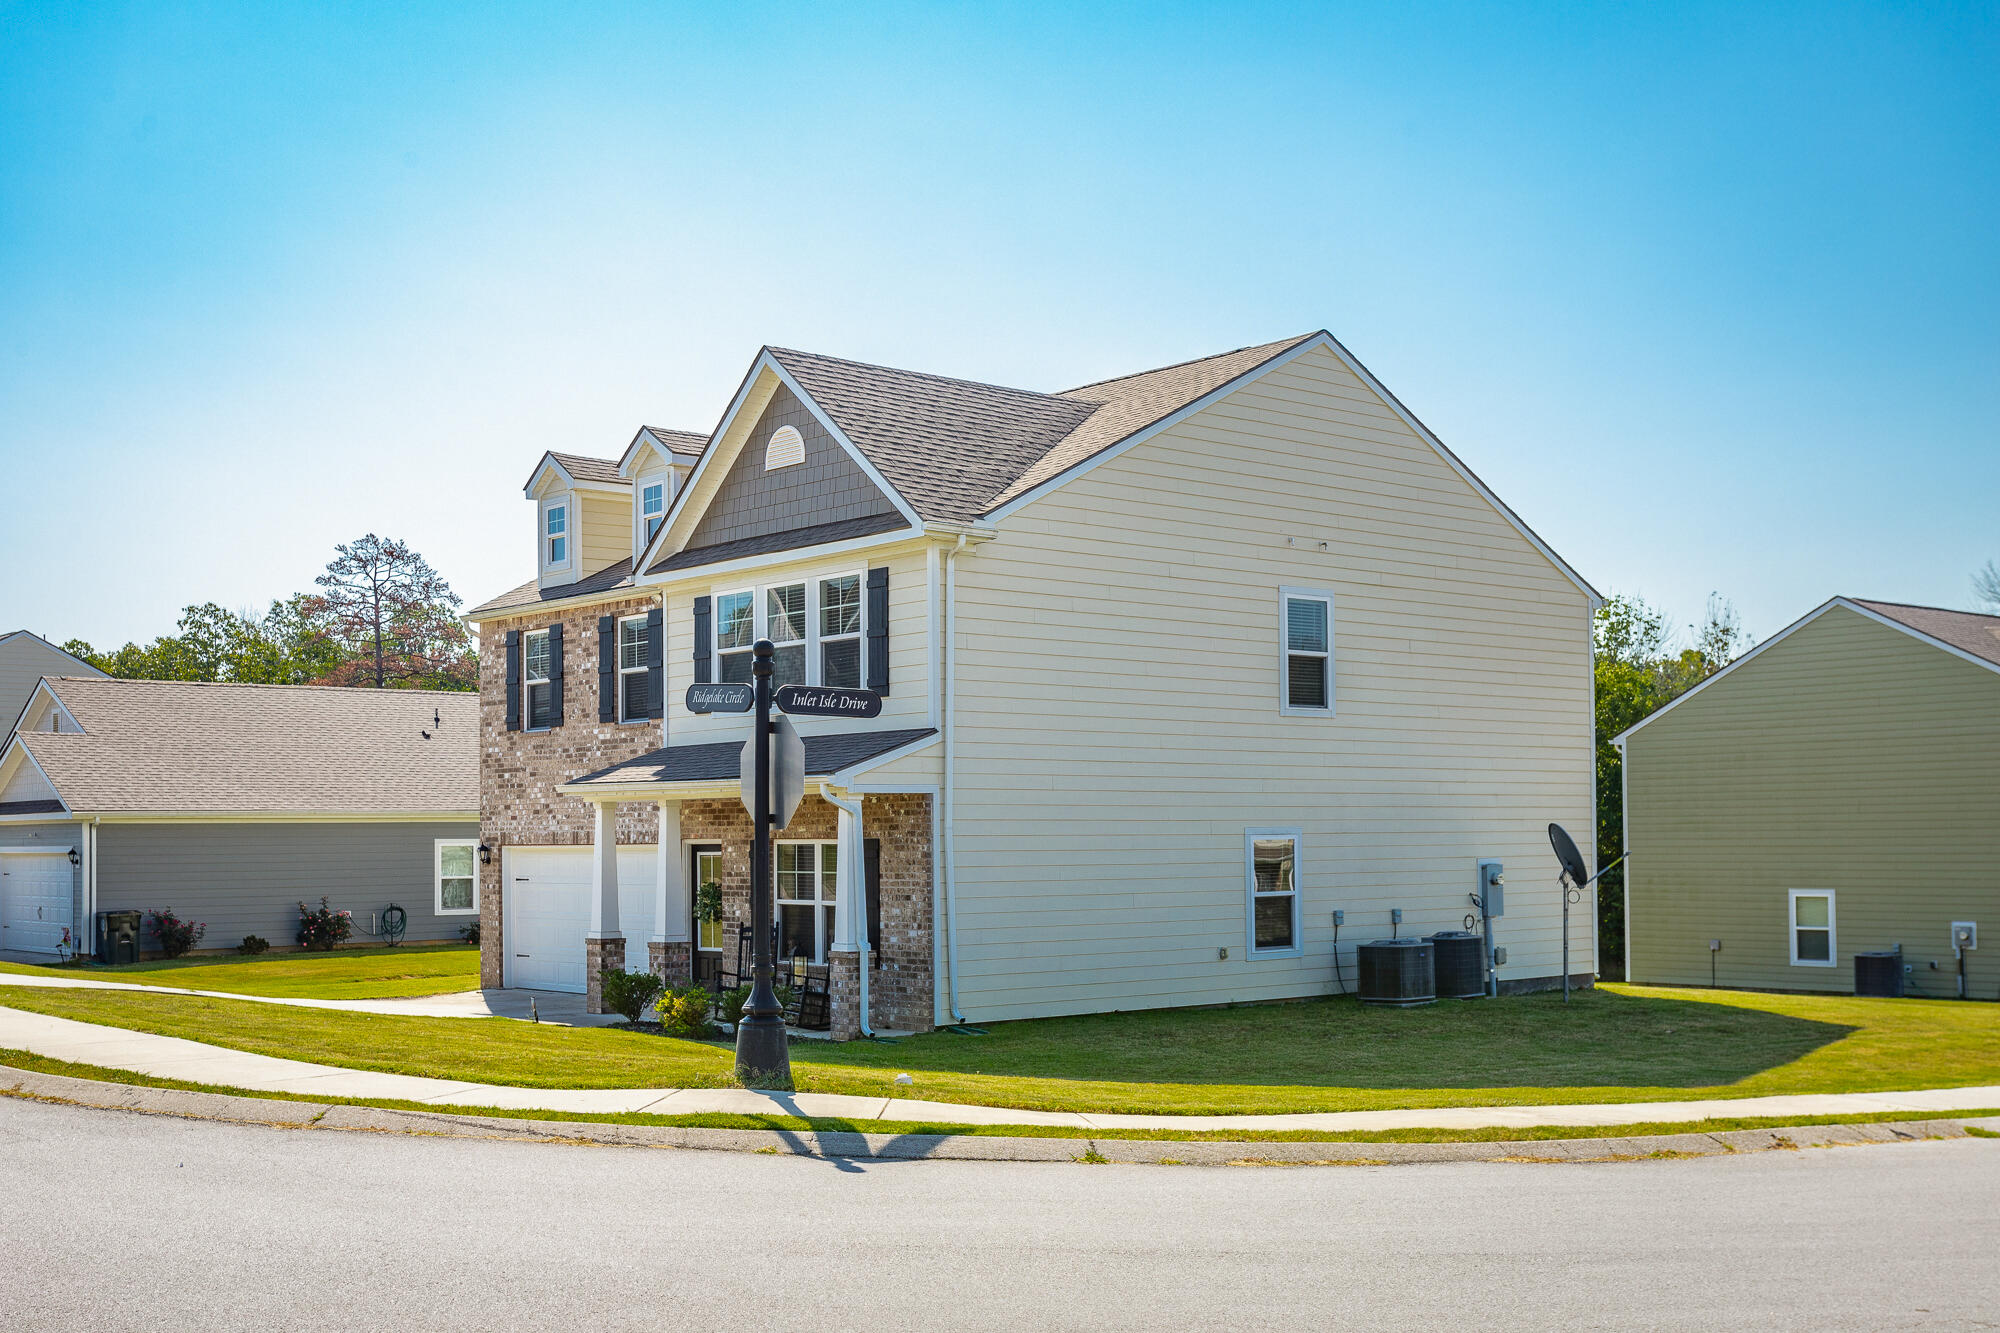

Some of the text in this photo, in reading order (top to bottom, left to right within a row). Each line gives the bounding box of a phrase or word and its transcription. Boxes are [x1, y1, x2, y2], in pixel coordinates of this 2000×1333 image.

[725, 688, 745, 704] Circle
[792, 691, 868, 710] Inlet Isle Drive
